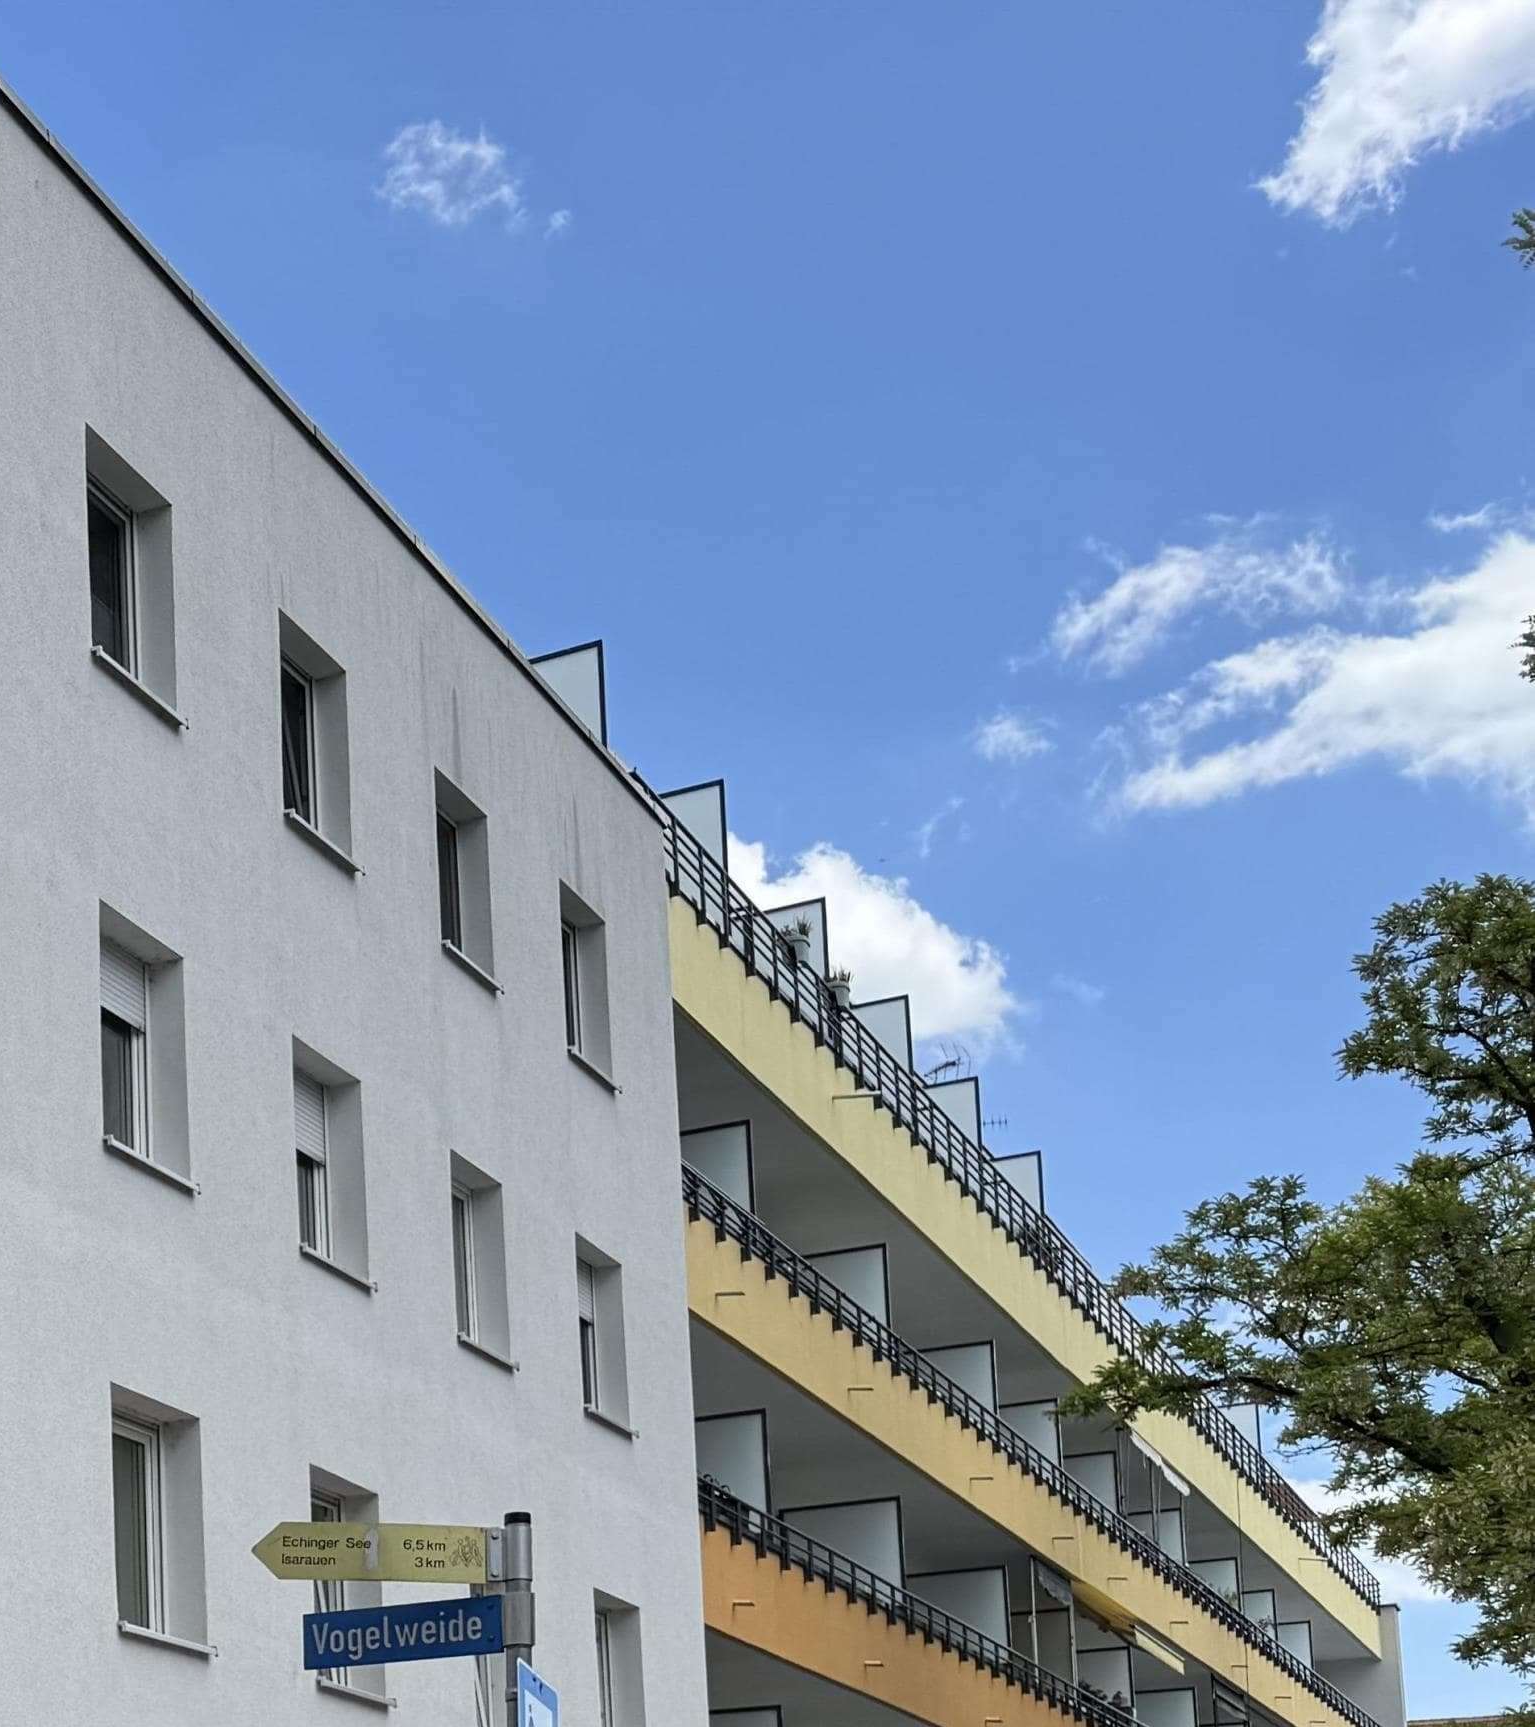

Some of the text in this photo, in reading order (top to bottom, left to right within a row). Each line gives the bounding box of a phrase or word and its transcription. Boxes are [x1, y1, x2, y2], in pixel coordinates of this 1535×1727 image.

[282, 1536, 371, 1550] Echinger See
[403, 1539, 446, 1552] 6,5 km
[281, 1553, 336, 1566] Isarauen
[414, 1556, 445, 1568] 3 km
[312, 1609, 482, 1661] Vogelweide
